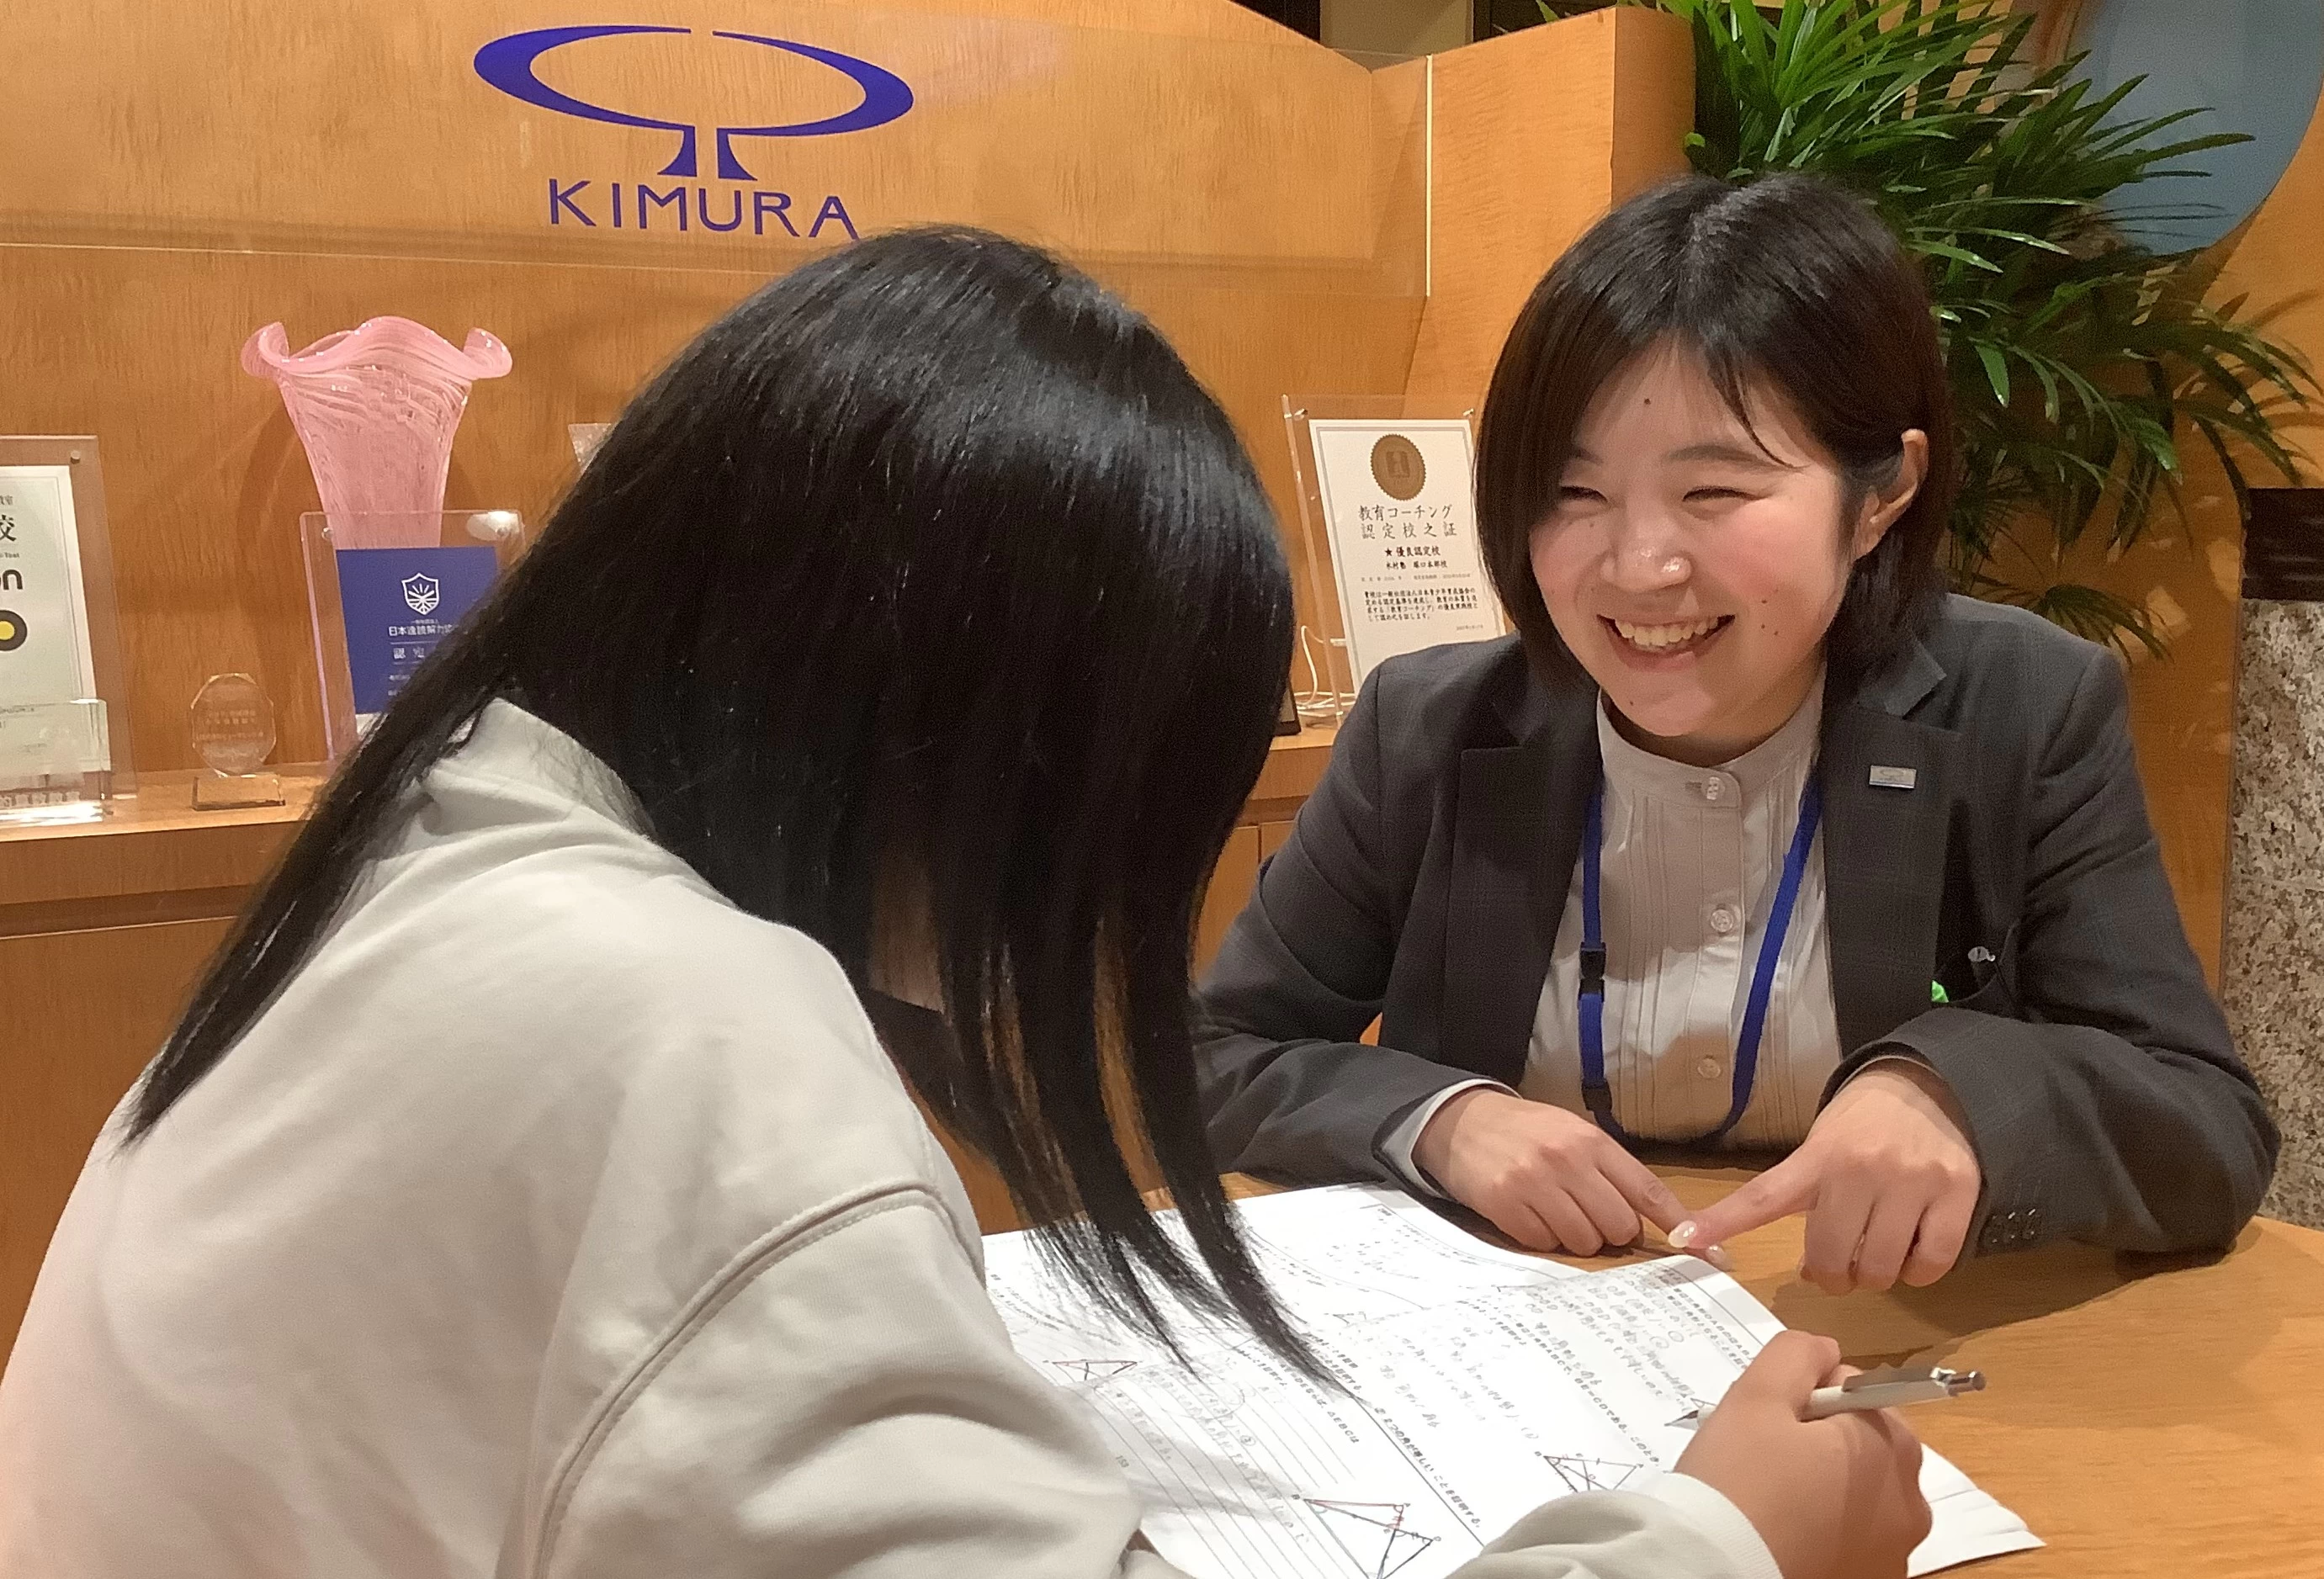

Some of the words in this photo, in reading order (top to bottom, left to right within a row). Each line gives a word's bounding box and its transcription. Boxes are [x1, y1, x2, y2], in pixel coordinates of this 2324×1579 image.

[549, 178, 861, 241] KIMURA
[1358, 505, 1452, 521] 教育コーチング
[1361, 522, 1457, 539] 認定校之証
